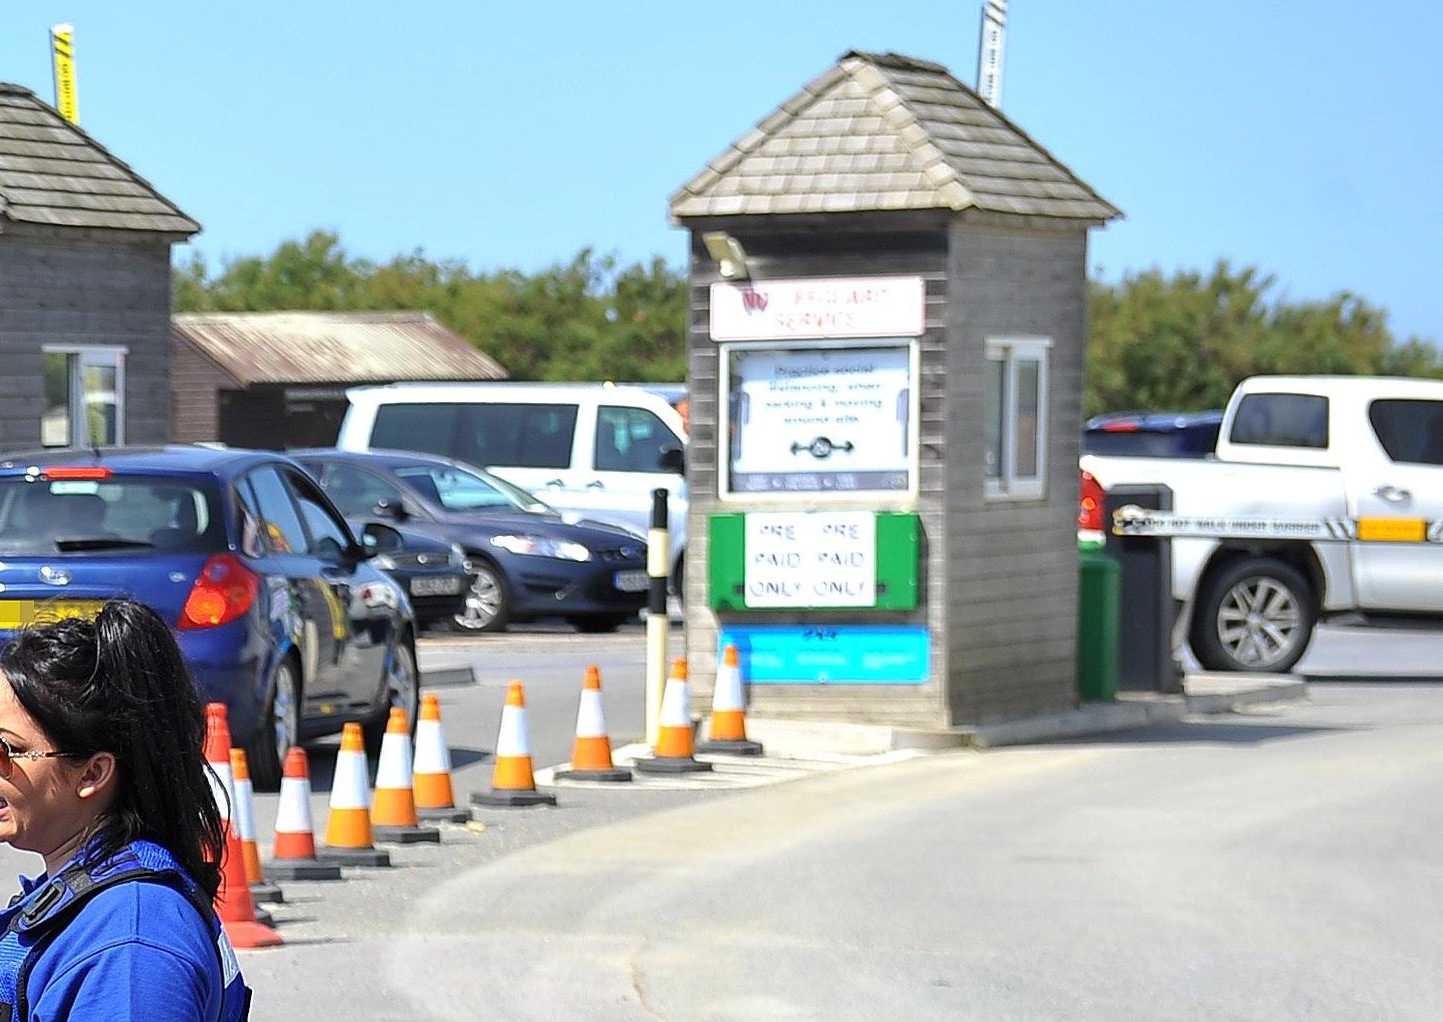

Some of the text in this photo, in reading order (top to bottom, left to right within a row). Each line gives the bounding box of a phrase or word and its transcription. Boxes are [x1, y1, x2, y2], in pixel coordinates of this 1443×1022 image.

[760, 524, 797, 541] PRE
[822, 524, 860, 540] PRE
[755, 552, 801, 568] PAID
[817, 551, 865, 567] PAID
[749, 581, 803, 598] ONLY
[813, 580, 865, 597] ONLY
